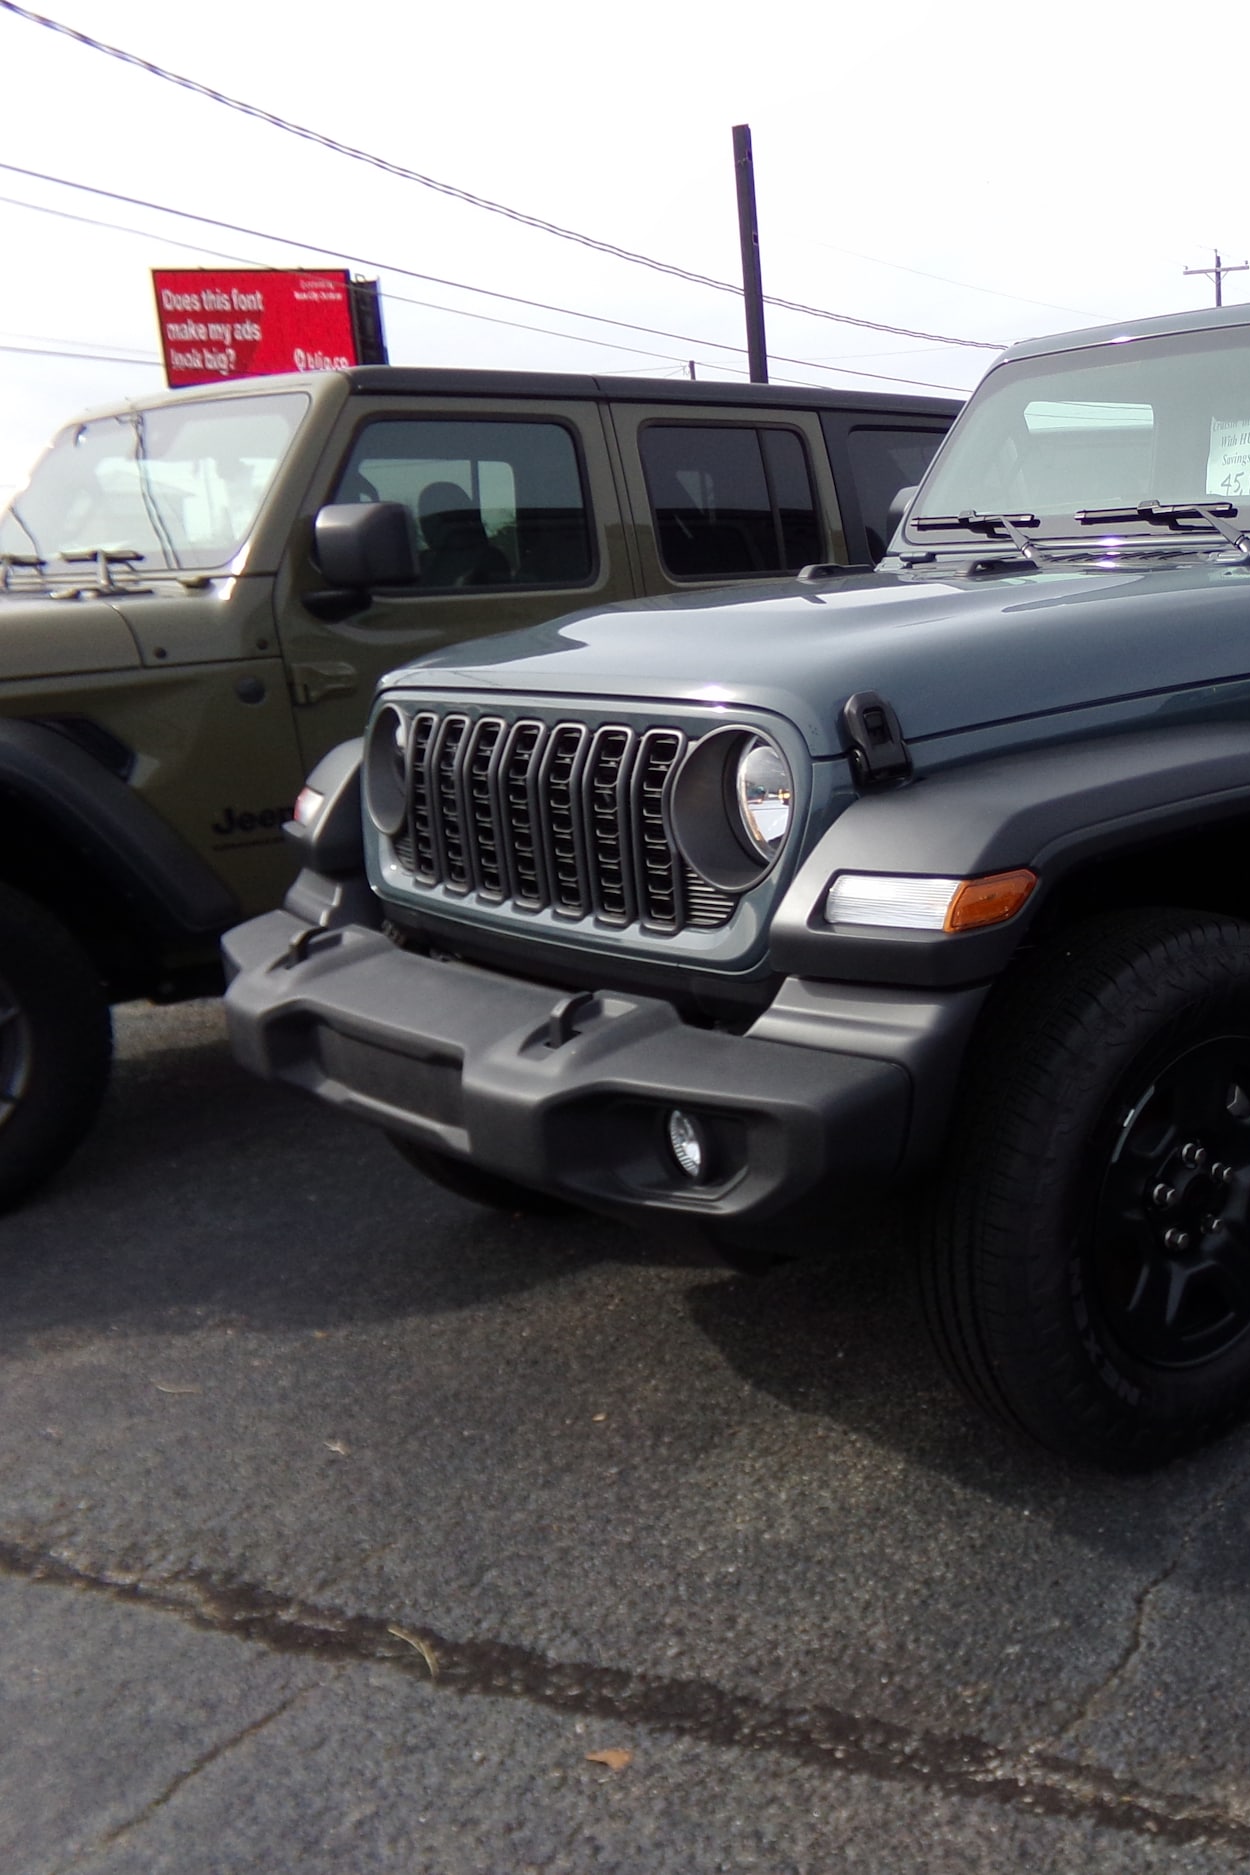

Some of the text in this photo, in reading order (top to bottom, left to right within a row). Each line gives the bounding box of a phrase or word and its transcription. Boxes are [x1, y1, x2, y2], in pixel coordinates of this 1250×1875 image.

[161, 288, 264, 311] Does this font
[167, 318, 262, 345] make my ads
[170, 348, 236, 374] look big?
[1221, 434, 1237, 448] With
[1222, 452, 1250, 465] Savings
